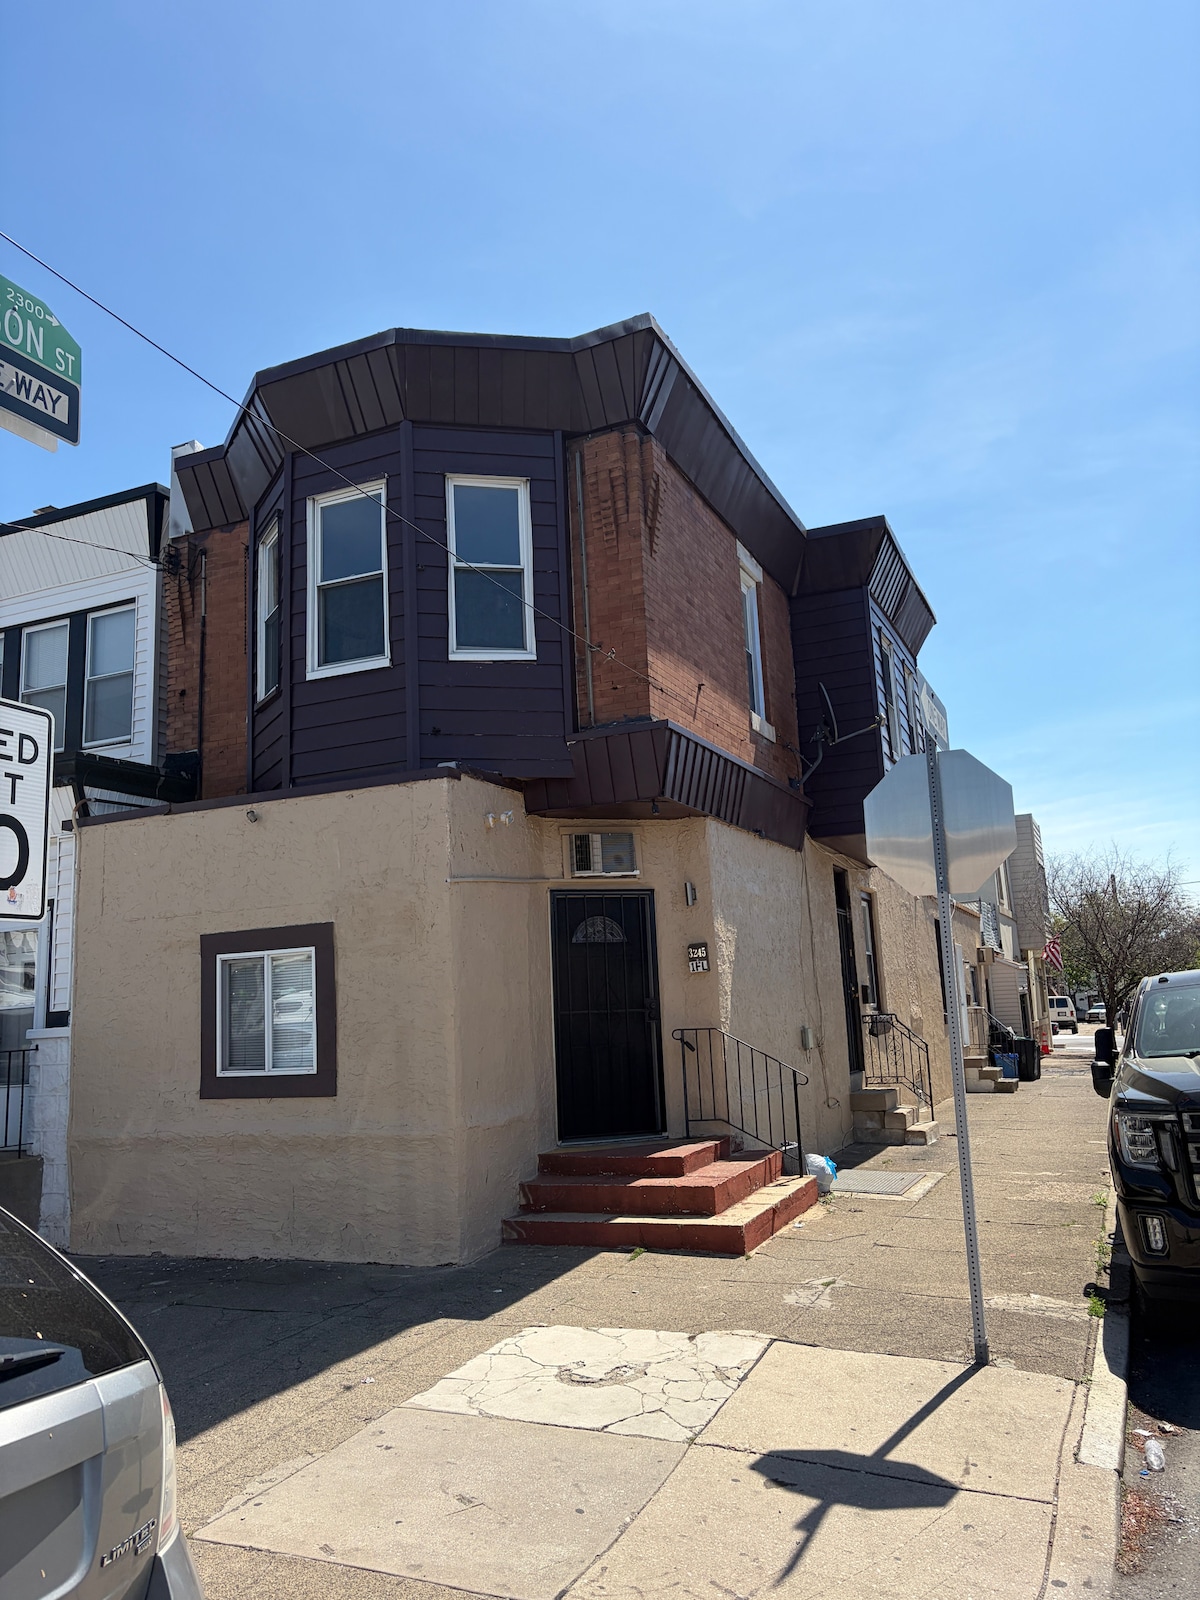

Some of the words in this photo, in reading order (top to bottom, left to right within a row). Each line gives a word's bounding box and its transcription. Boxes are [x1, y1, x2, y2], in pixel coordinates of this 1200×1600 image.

[6, 287, 44, 320] 2300
[0, 305, 44, 361] ON
[55, 347, 76, 377] ST
[14, 370, 63, 415] WAY
[0, 728, 39, 764] ED
[4, 771, 24, 805] T
[688, 947, 707, 958] 3245
[101, 1517, 157, 1568] LIMITED
